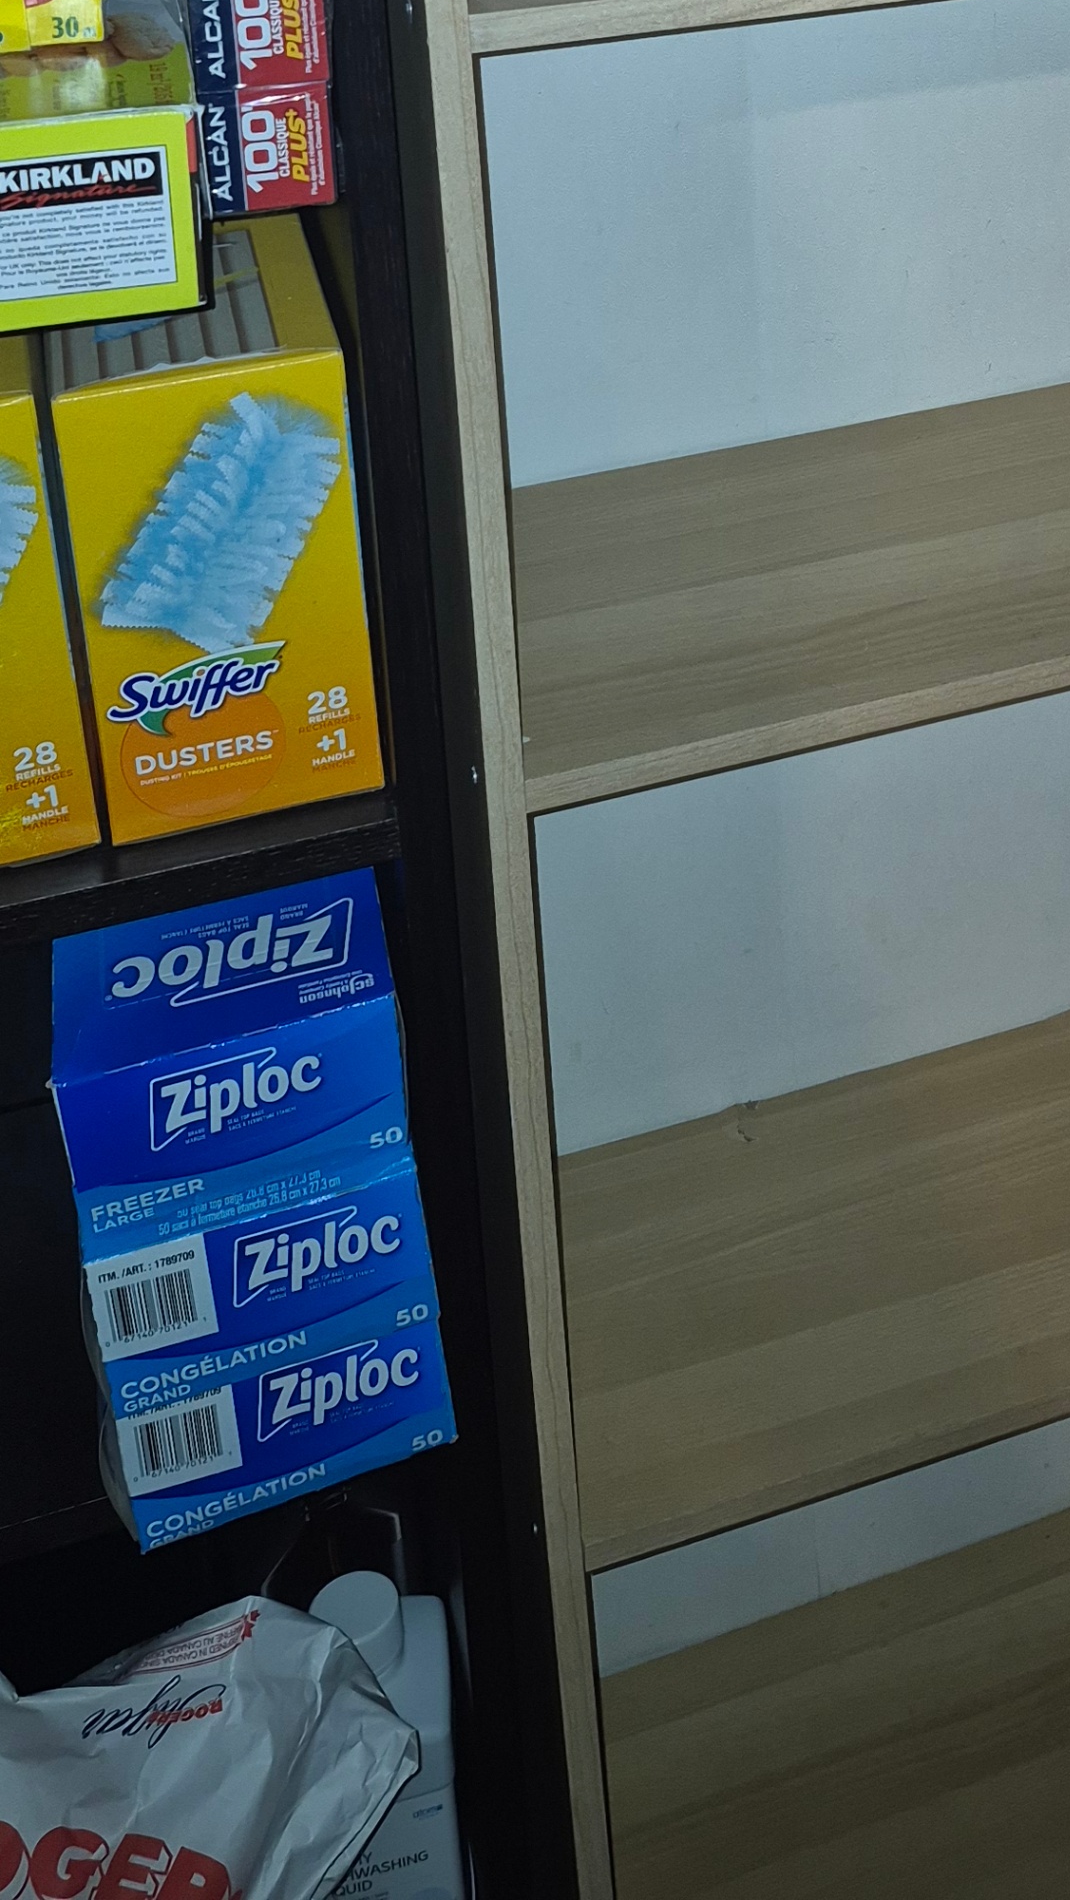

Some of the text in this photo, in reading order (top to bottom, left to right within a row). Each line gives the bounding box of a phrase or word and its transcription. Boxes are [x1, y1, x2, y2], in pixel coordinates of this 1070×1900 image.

[52, 16, 79, 38] 30
[209, 102, 233, 201] ALCAN
[275, 117, 290, 178] CLASSIQUE
[0, 158, 155, 193] KIRKLAND
[108, 659, 279, 720] Swiffer
[307, 686, 347, 715] 28
[299, 714, 361, 734] RECHARGES
[308, 708, 350, 724] REFILLS
[135, 730, 275, 775] DUSTERS
[317, 728, 346, 751] +1
[14, 741, 57, 772] 28
[312, 750, 355, 766] HANDLE
[312, 759, 356, 773] MANCHE
[6, 769, 74, 791] RECHARGES
[16, 764, 61, 781] REFILLS
[26, 784, 58, 808] +1
[22, 805, 69, 824] HANDLE
[23, 814, 70, 831] MANCHE
[109, 914, 335, 999] Ziploc
[161, 1055, 322, 1134] Ziploc
[369, 1127, 403, 1149] 50
[90, 1178, 205, 1222] FREEZER
[158, 1223, 170, 1237] 50
[288, 1189, 301, 1199] cm
[327, 1175, 341, 1188] cm
[93, 1207, 155, 1233] LARGE
[154, 1250, 195, 1269] 1789709
[245, 1215, 400, 1292] Ziploc
[396, 1303, 429, 1327] 50
[120, 1330, 307, 1399] CONGÉLATION
[123, 1384, 191, 1412] GRAND
[270, 1348, 419, 1426] Ziploc
[411, 1429, 443, 1451] 50
[147, 1463, 326, 1537] CONGÉLATION
